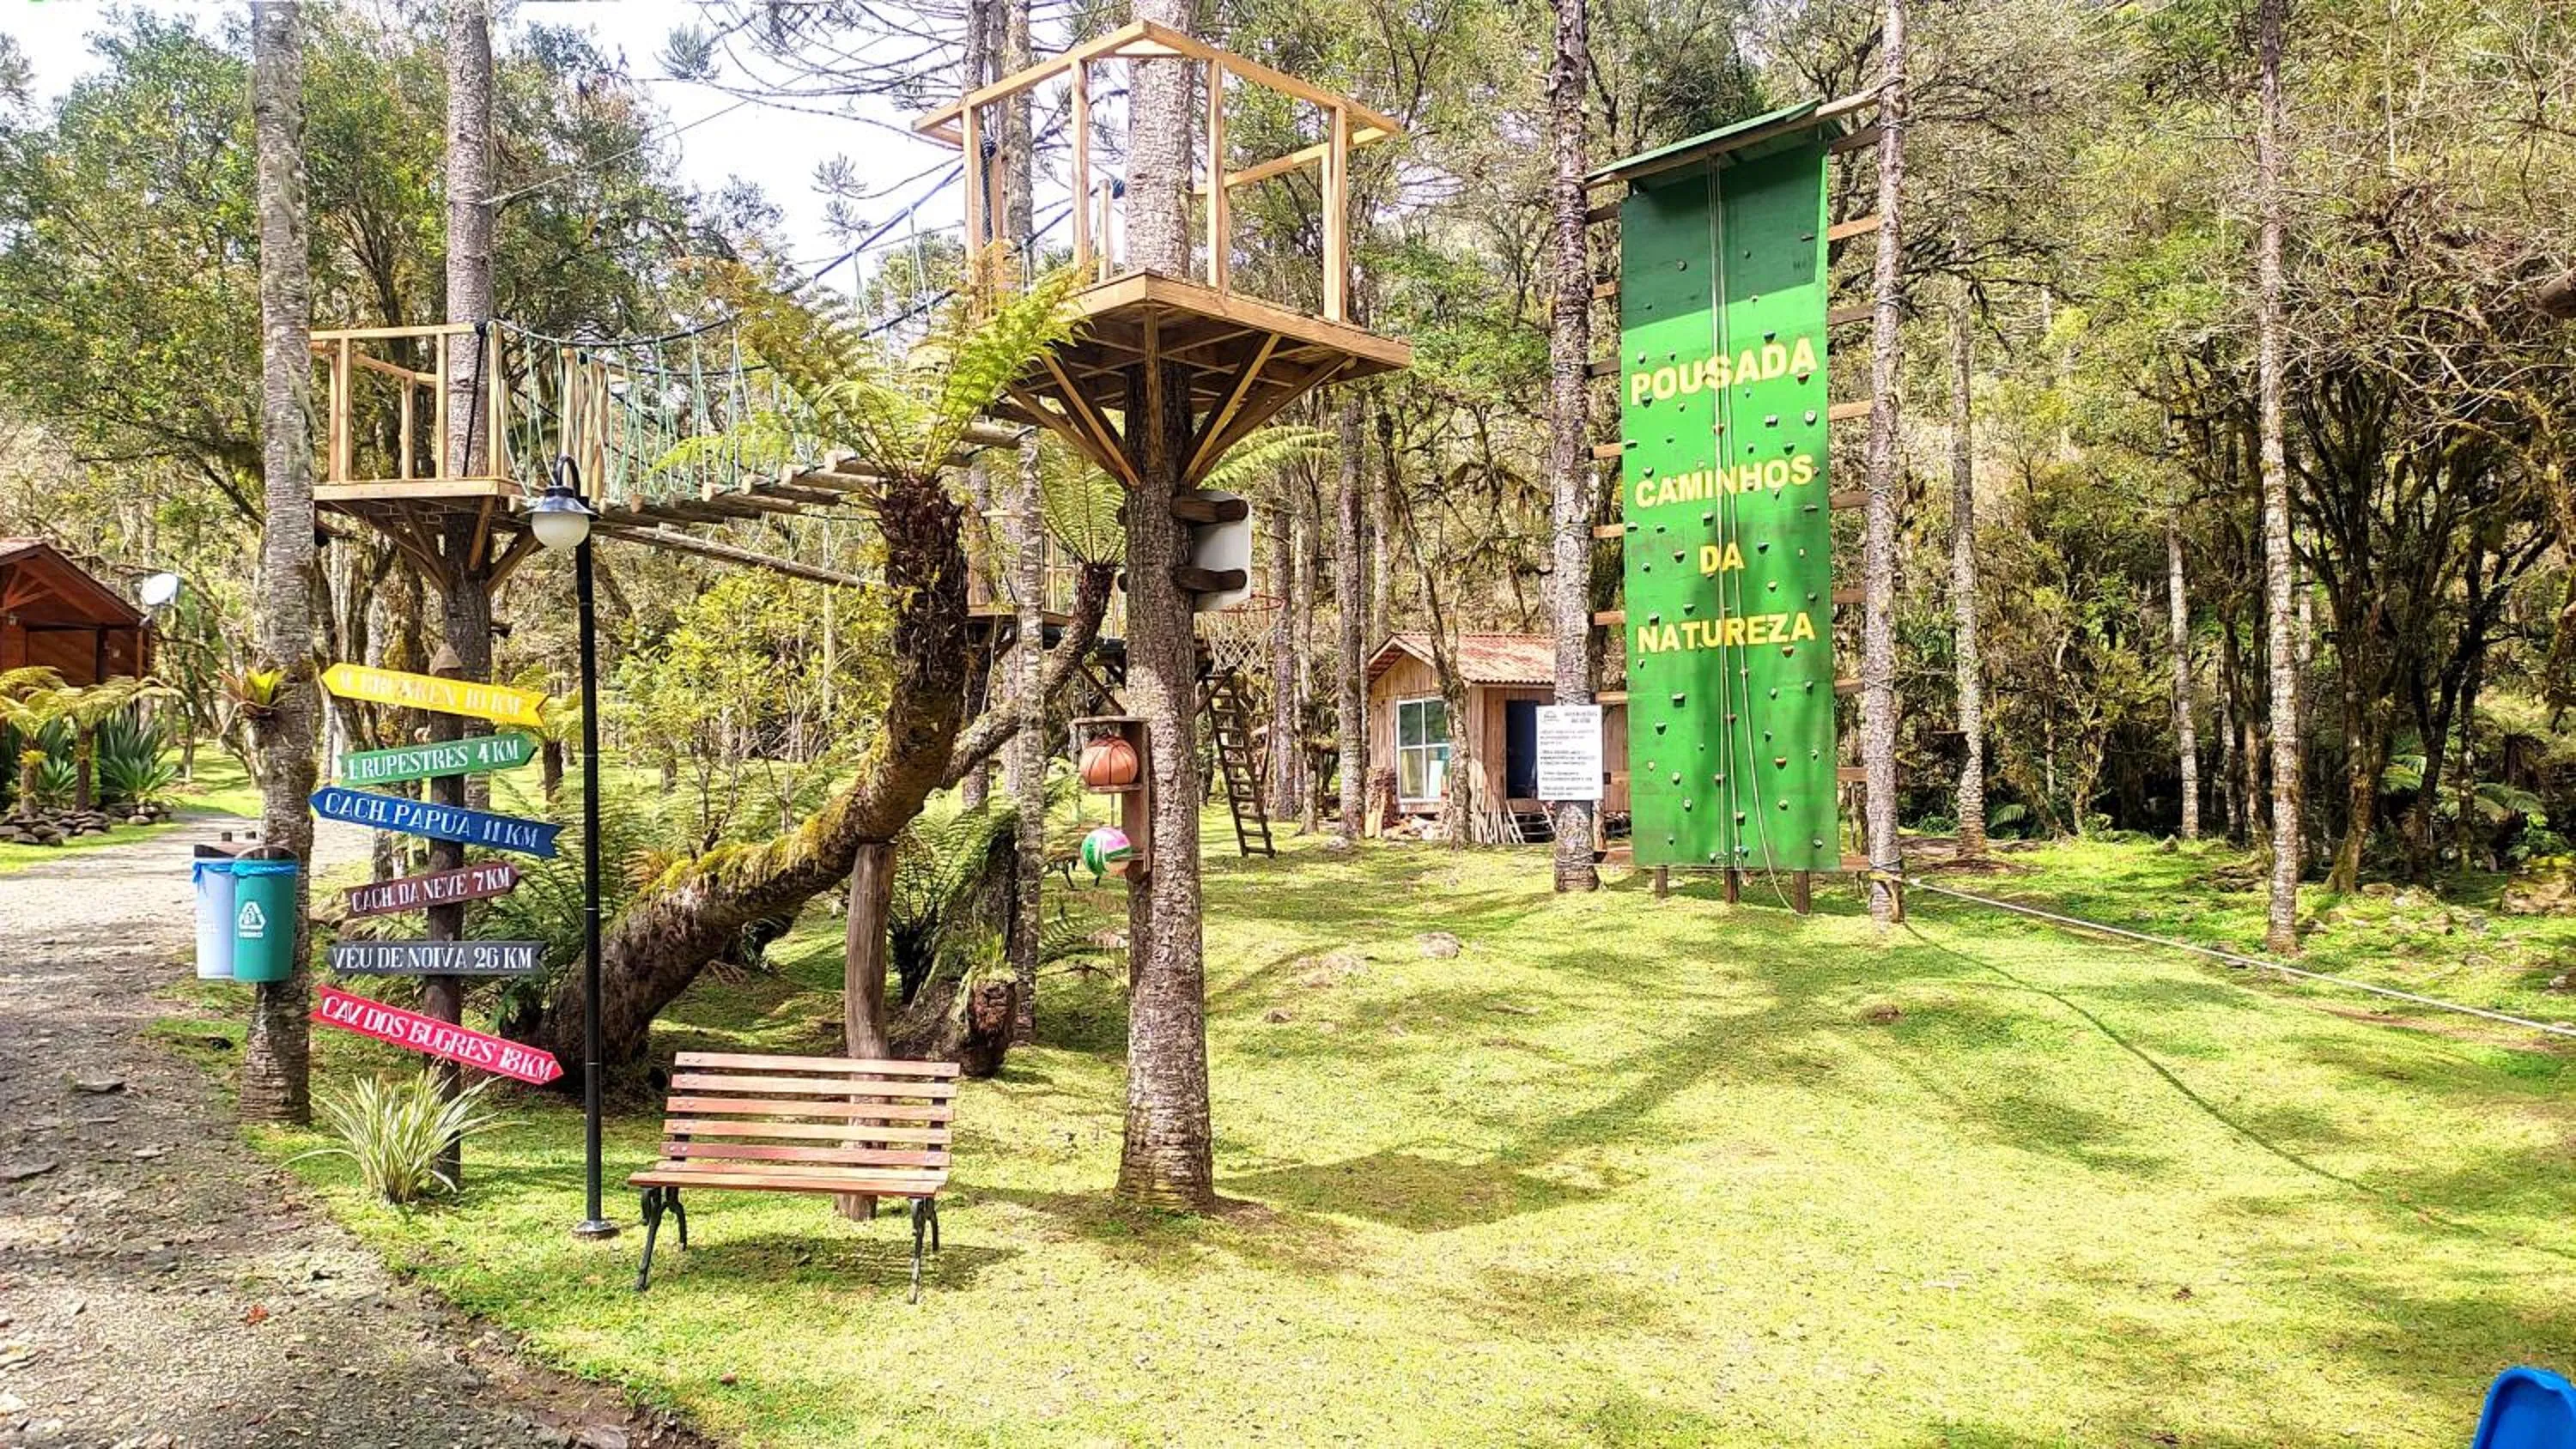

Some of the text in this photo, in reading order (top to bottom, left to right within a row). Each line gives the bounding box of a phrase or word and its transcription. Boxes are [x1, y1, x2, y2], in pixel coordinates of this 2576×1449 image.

[1631, 337, 1818, 406] POUSADA
[1635, 455, 1814, 508] CAMINHOS
[1699, 542, 1745, 573] DA
[1637, 612, 1815, 653] NATUREZA
[361, 745, 468, 779] RUPESTRES
[477, 742, 489, 764] 4
[492, 738, 519, 761] KM
[503, 822, 539, 848] KM
[398, 882, 420, 905] DA
[422, 873, 468, 899] NEVE
[471, 871, 483, 892] 7
[486, 866, 510, 890] KM
[331, 943, 532, 970] VÉU DE NOIVA 26 KM
[363, 1008, 408, 1040] DOS
[409, 1020, 497, 1064] BUGRES
[497, 1046, 523, 1073] 18
[520, 1053, 556, 1083] KM
